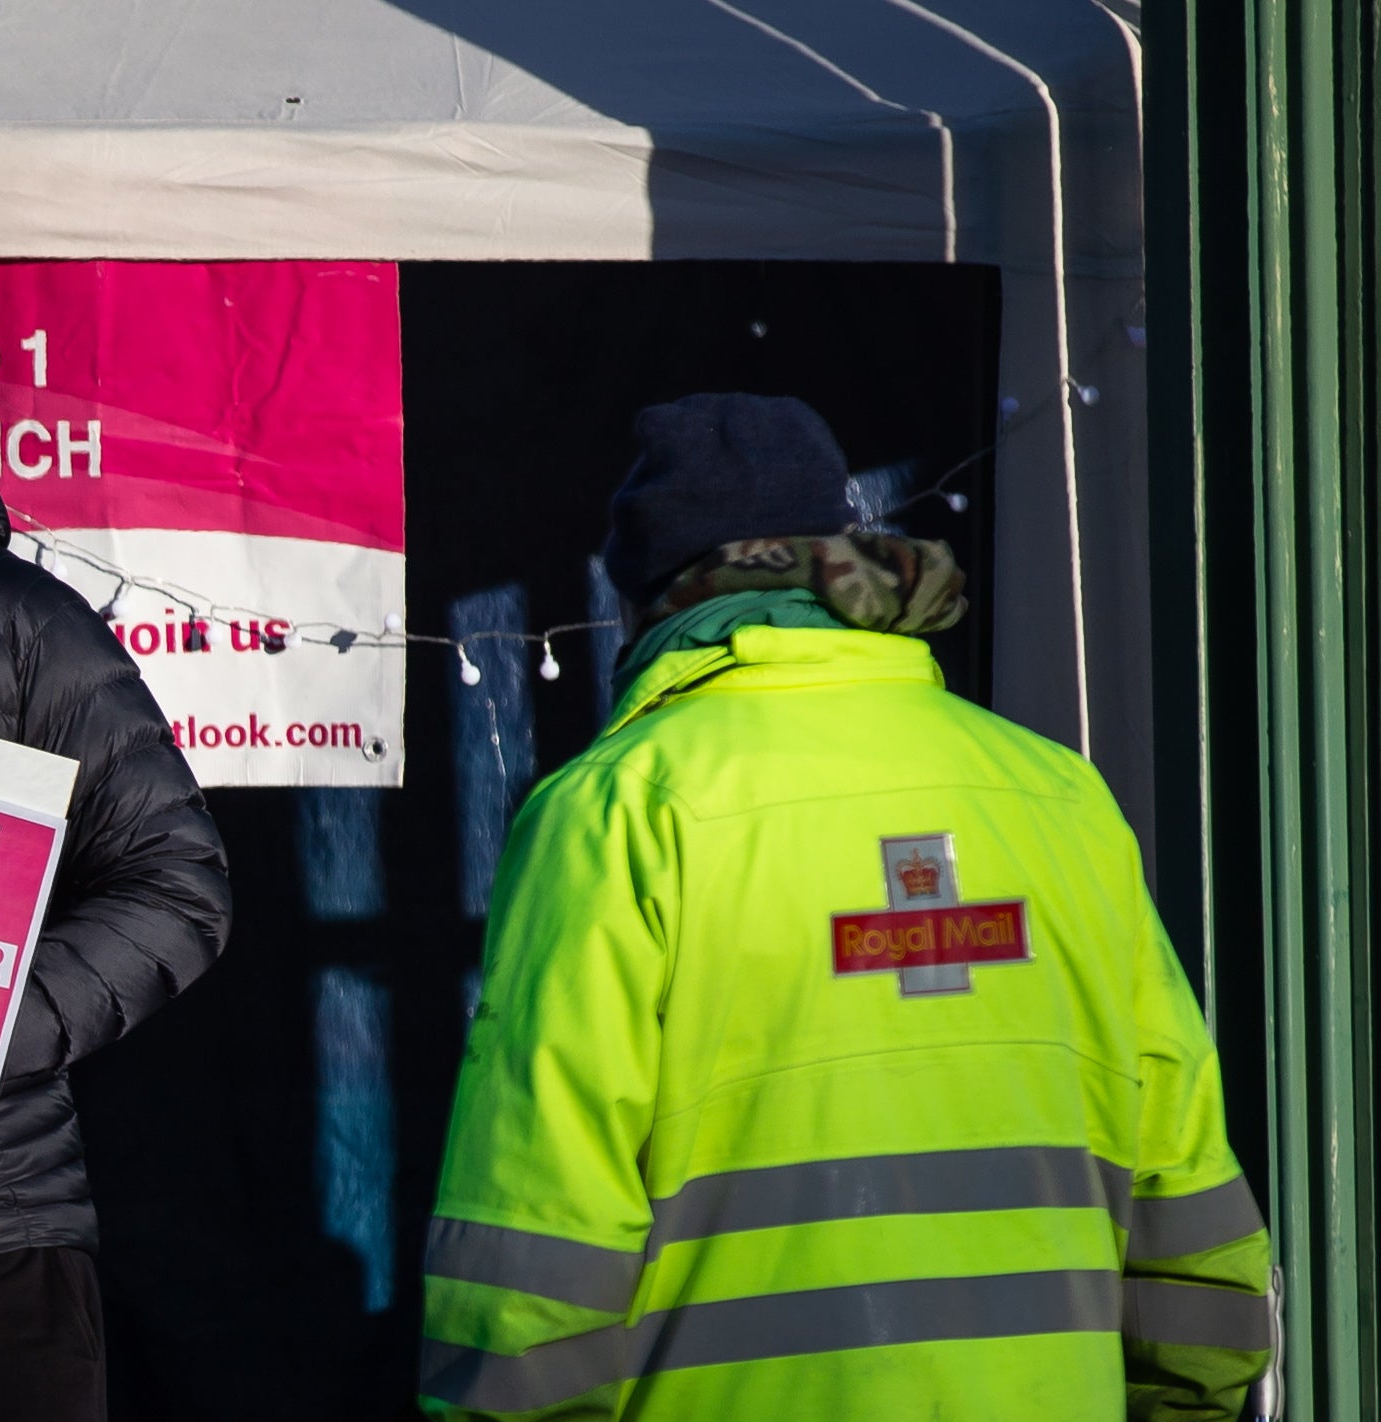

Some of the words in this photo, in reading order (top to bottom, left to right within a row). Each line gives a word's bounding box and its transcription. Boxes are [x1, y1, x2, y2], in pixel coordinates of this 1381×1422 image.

[21, 328, 48, 388] 1
[229, 616, 292, 654] us
[841, 916, 936, 962] Royal
[942, 911, 1017, 949] Mail
